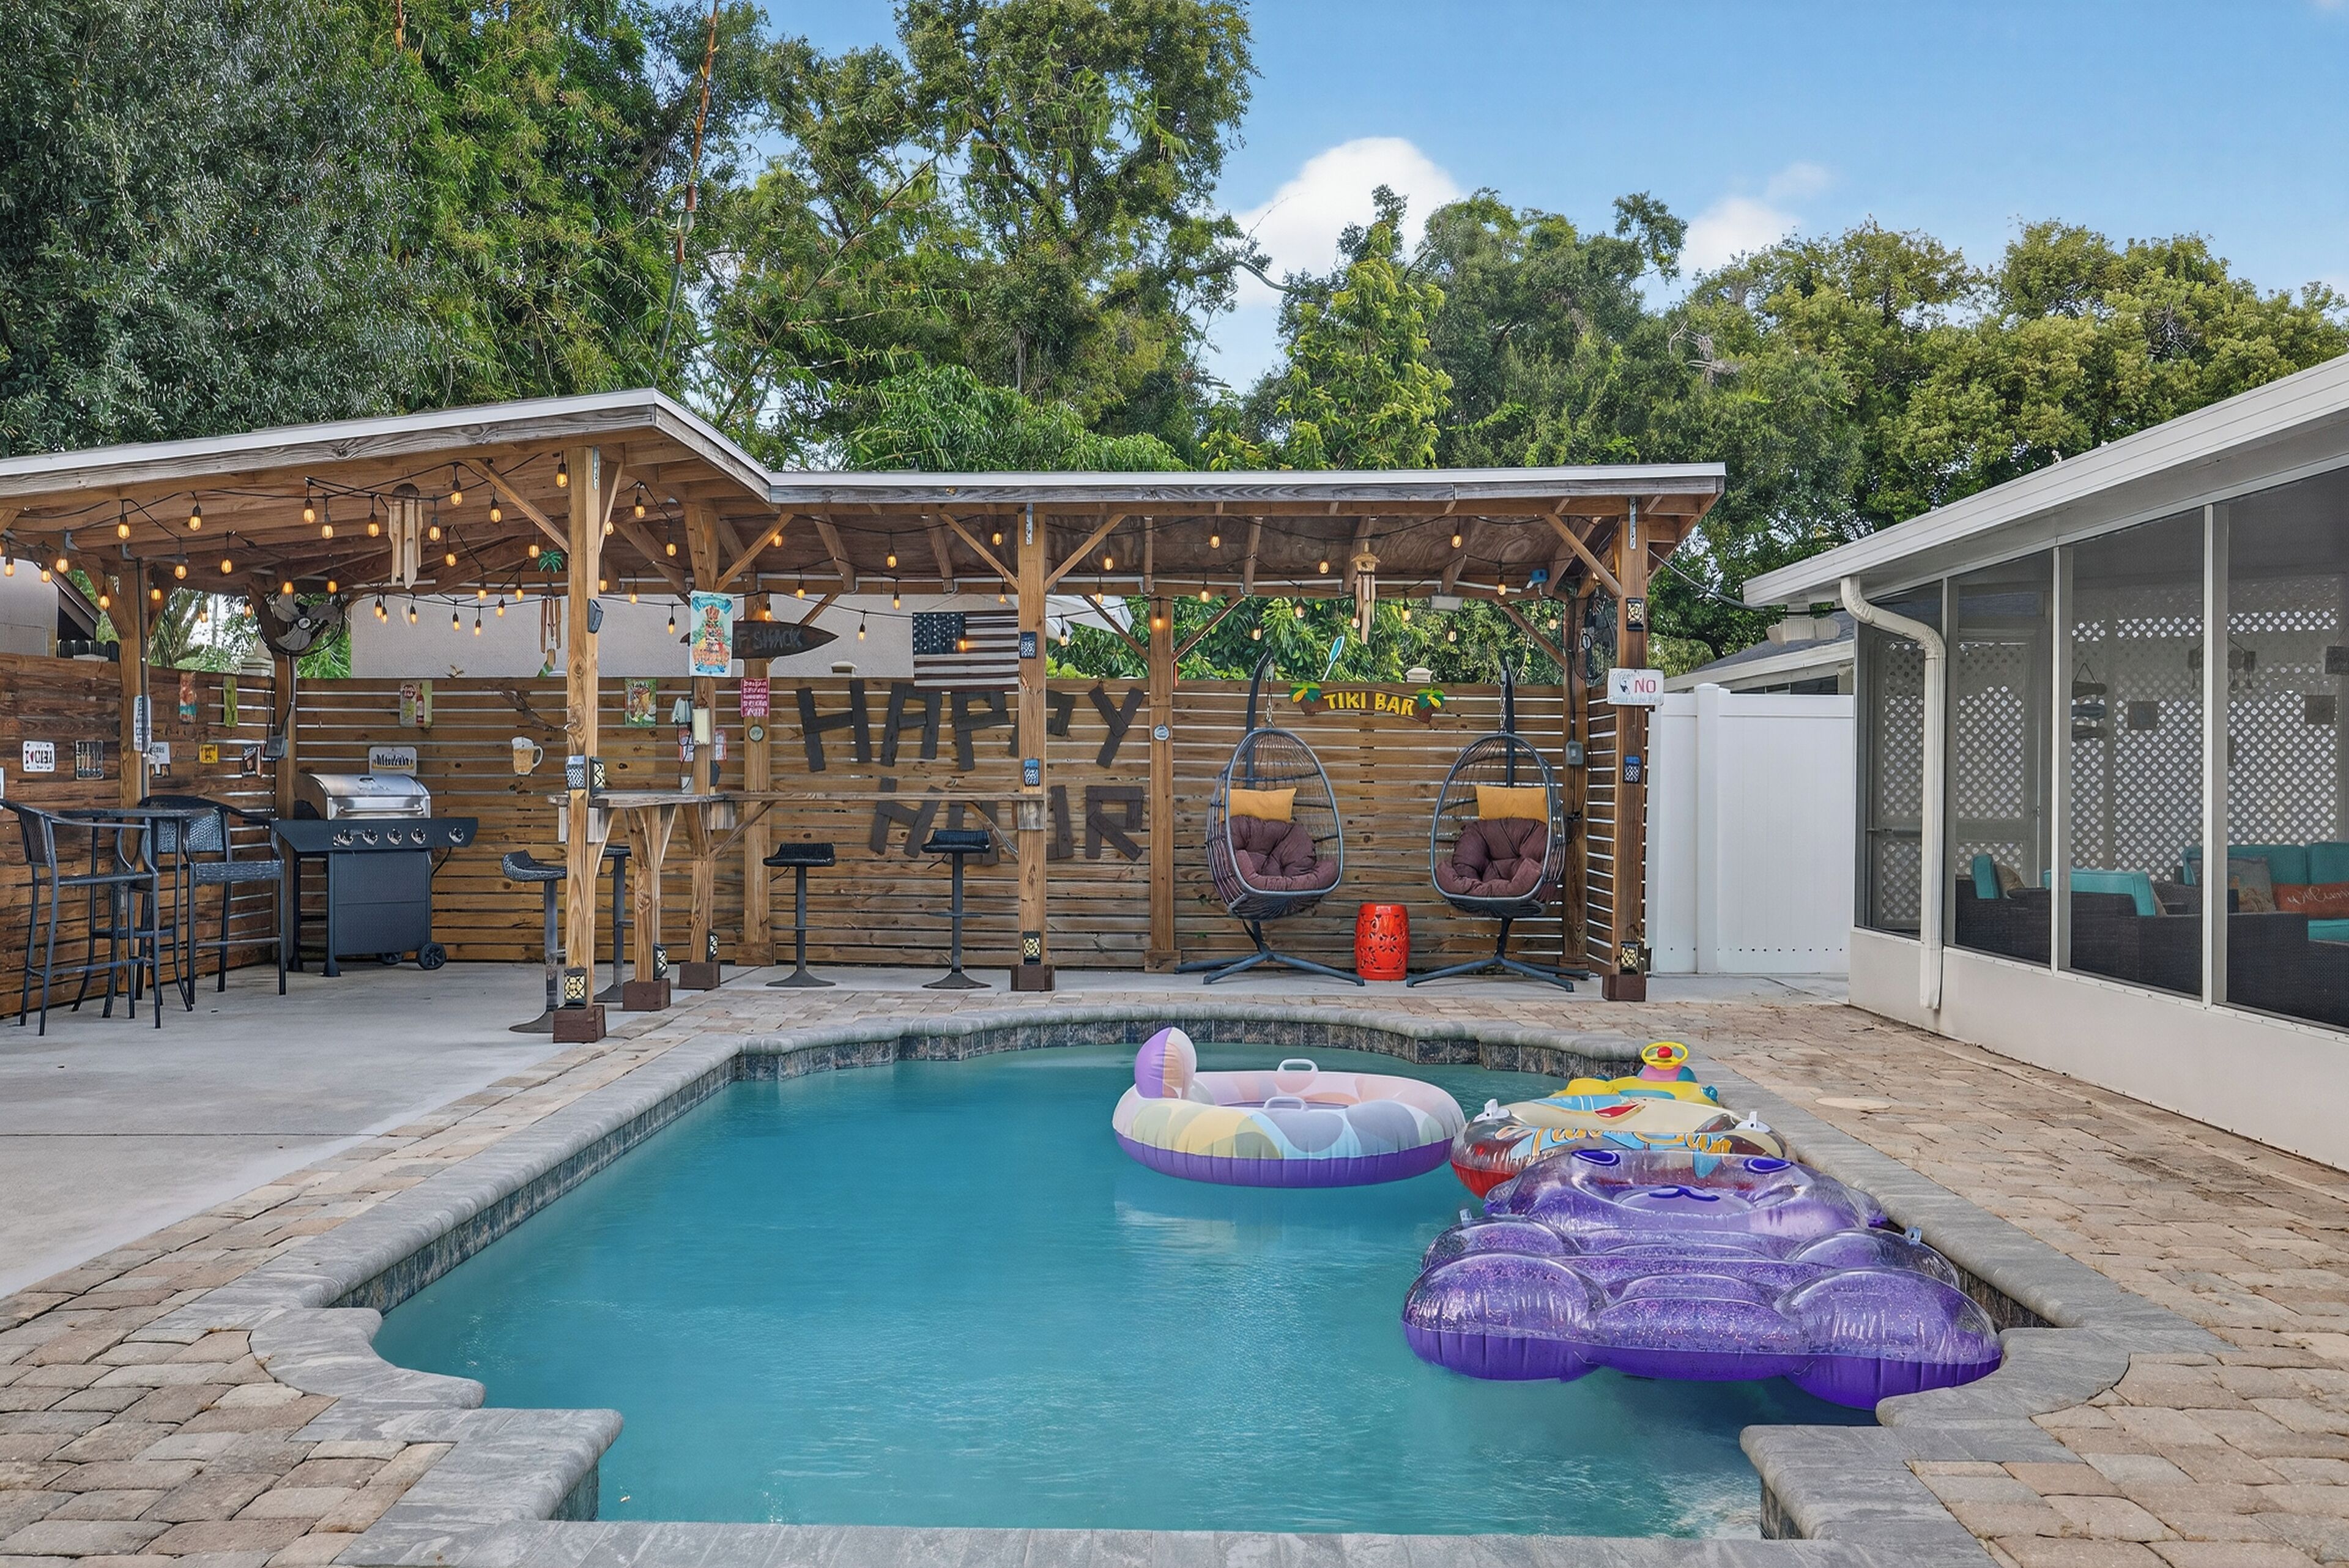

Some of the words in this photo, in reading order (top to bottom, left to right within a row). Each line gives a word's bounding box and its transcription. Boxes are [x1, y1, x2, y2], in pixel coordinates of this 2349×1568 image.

[1634, 677, 1656, 693] NO
[1323, 691, 1366, 709] TIKI
[1374, 692, 1414, 716] BAR
